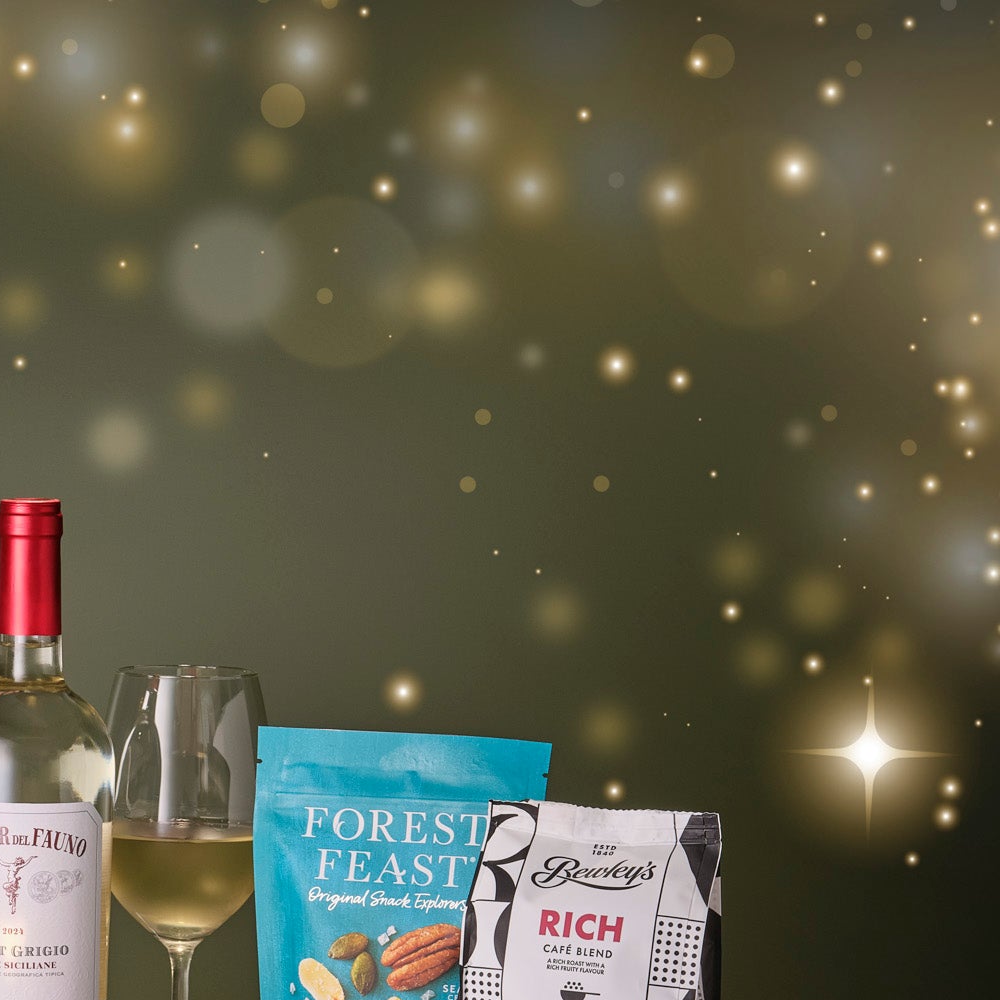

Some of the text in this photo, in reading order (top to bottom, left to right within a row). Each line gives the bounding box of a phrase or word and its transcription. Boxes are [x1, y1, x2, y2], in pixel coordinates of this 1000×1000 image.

[301, 806, 488, 847] FOREST
[12, 834, 30, 846] DEL
[32, 827, 87, 858] FAUNO
[314, 848, 467, 889] FEAST
[530, 855, 657, 890] Bewley's
[308, 886, 468, 913] Original Snack Explorers
[538, 909, 625, 943] RICH
[4, 961, 57, 969] SICILIANE
[12, 944, 70, 957] GRIGIO
[543, 943, 613, 959] CAFÉ BLEND
[580, 967, 605, 975] FLAVOUR
